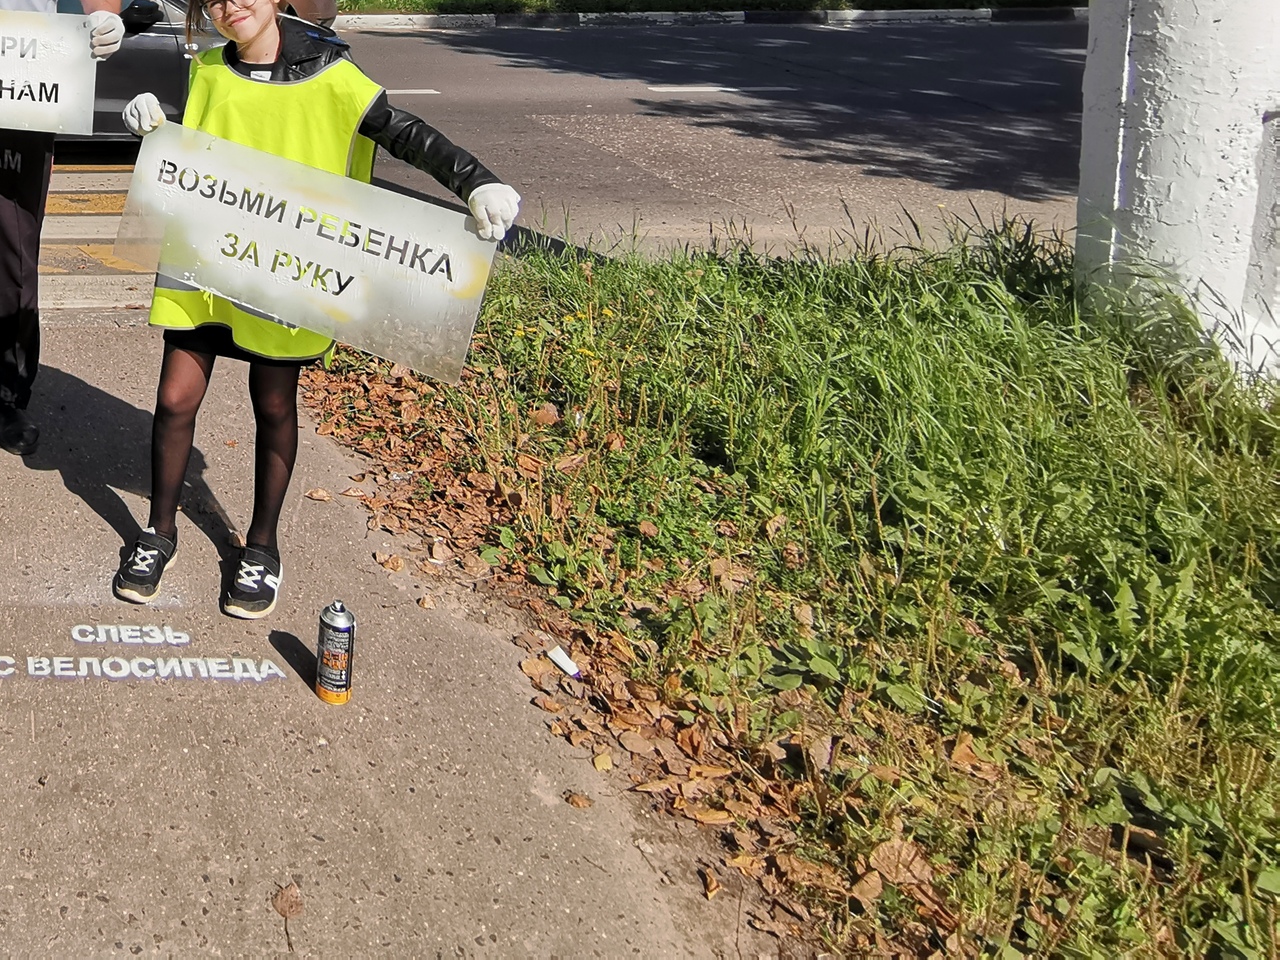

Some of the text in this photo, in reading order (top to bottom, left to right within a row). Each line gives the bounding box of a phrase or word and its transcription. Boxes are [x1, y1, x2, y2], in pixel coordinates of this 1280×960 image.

[156, 159, 454, 283] ВОЗЬМИ РЕБЕНКА
[219, 232, 355, 296] ЗА РУКУ
[71, 624, 191, 646] СЛЕЗЬ
[26, 655, 289, 682] ВЕЛОСИПЕДА
